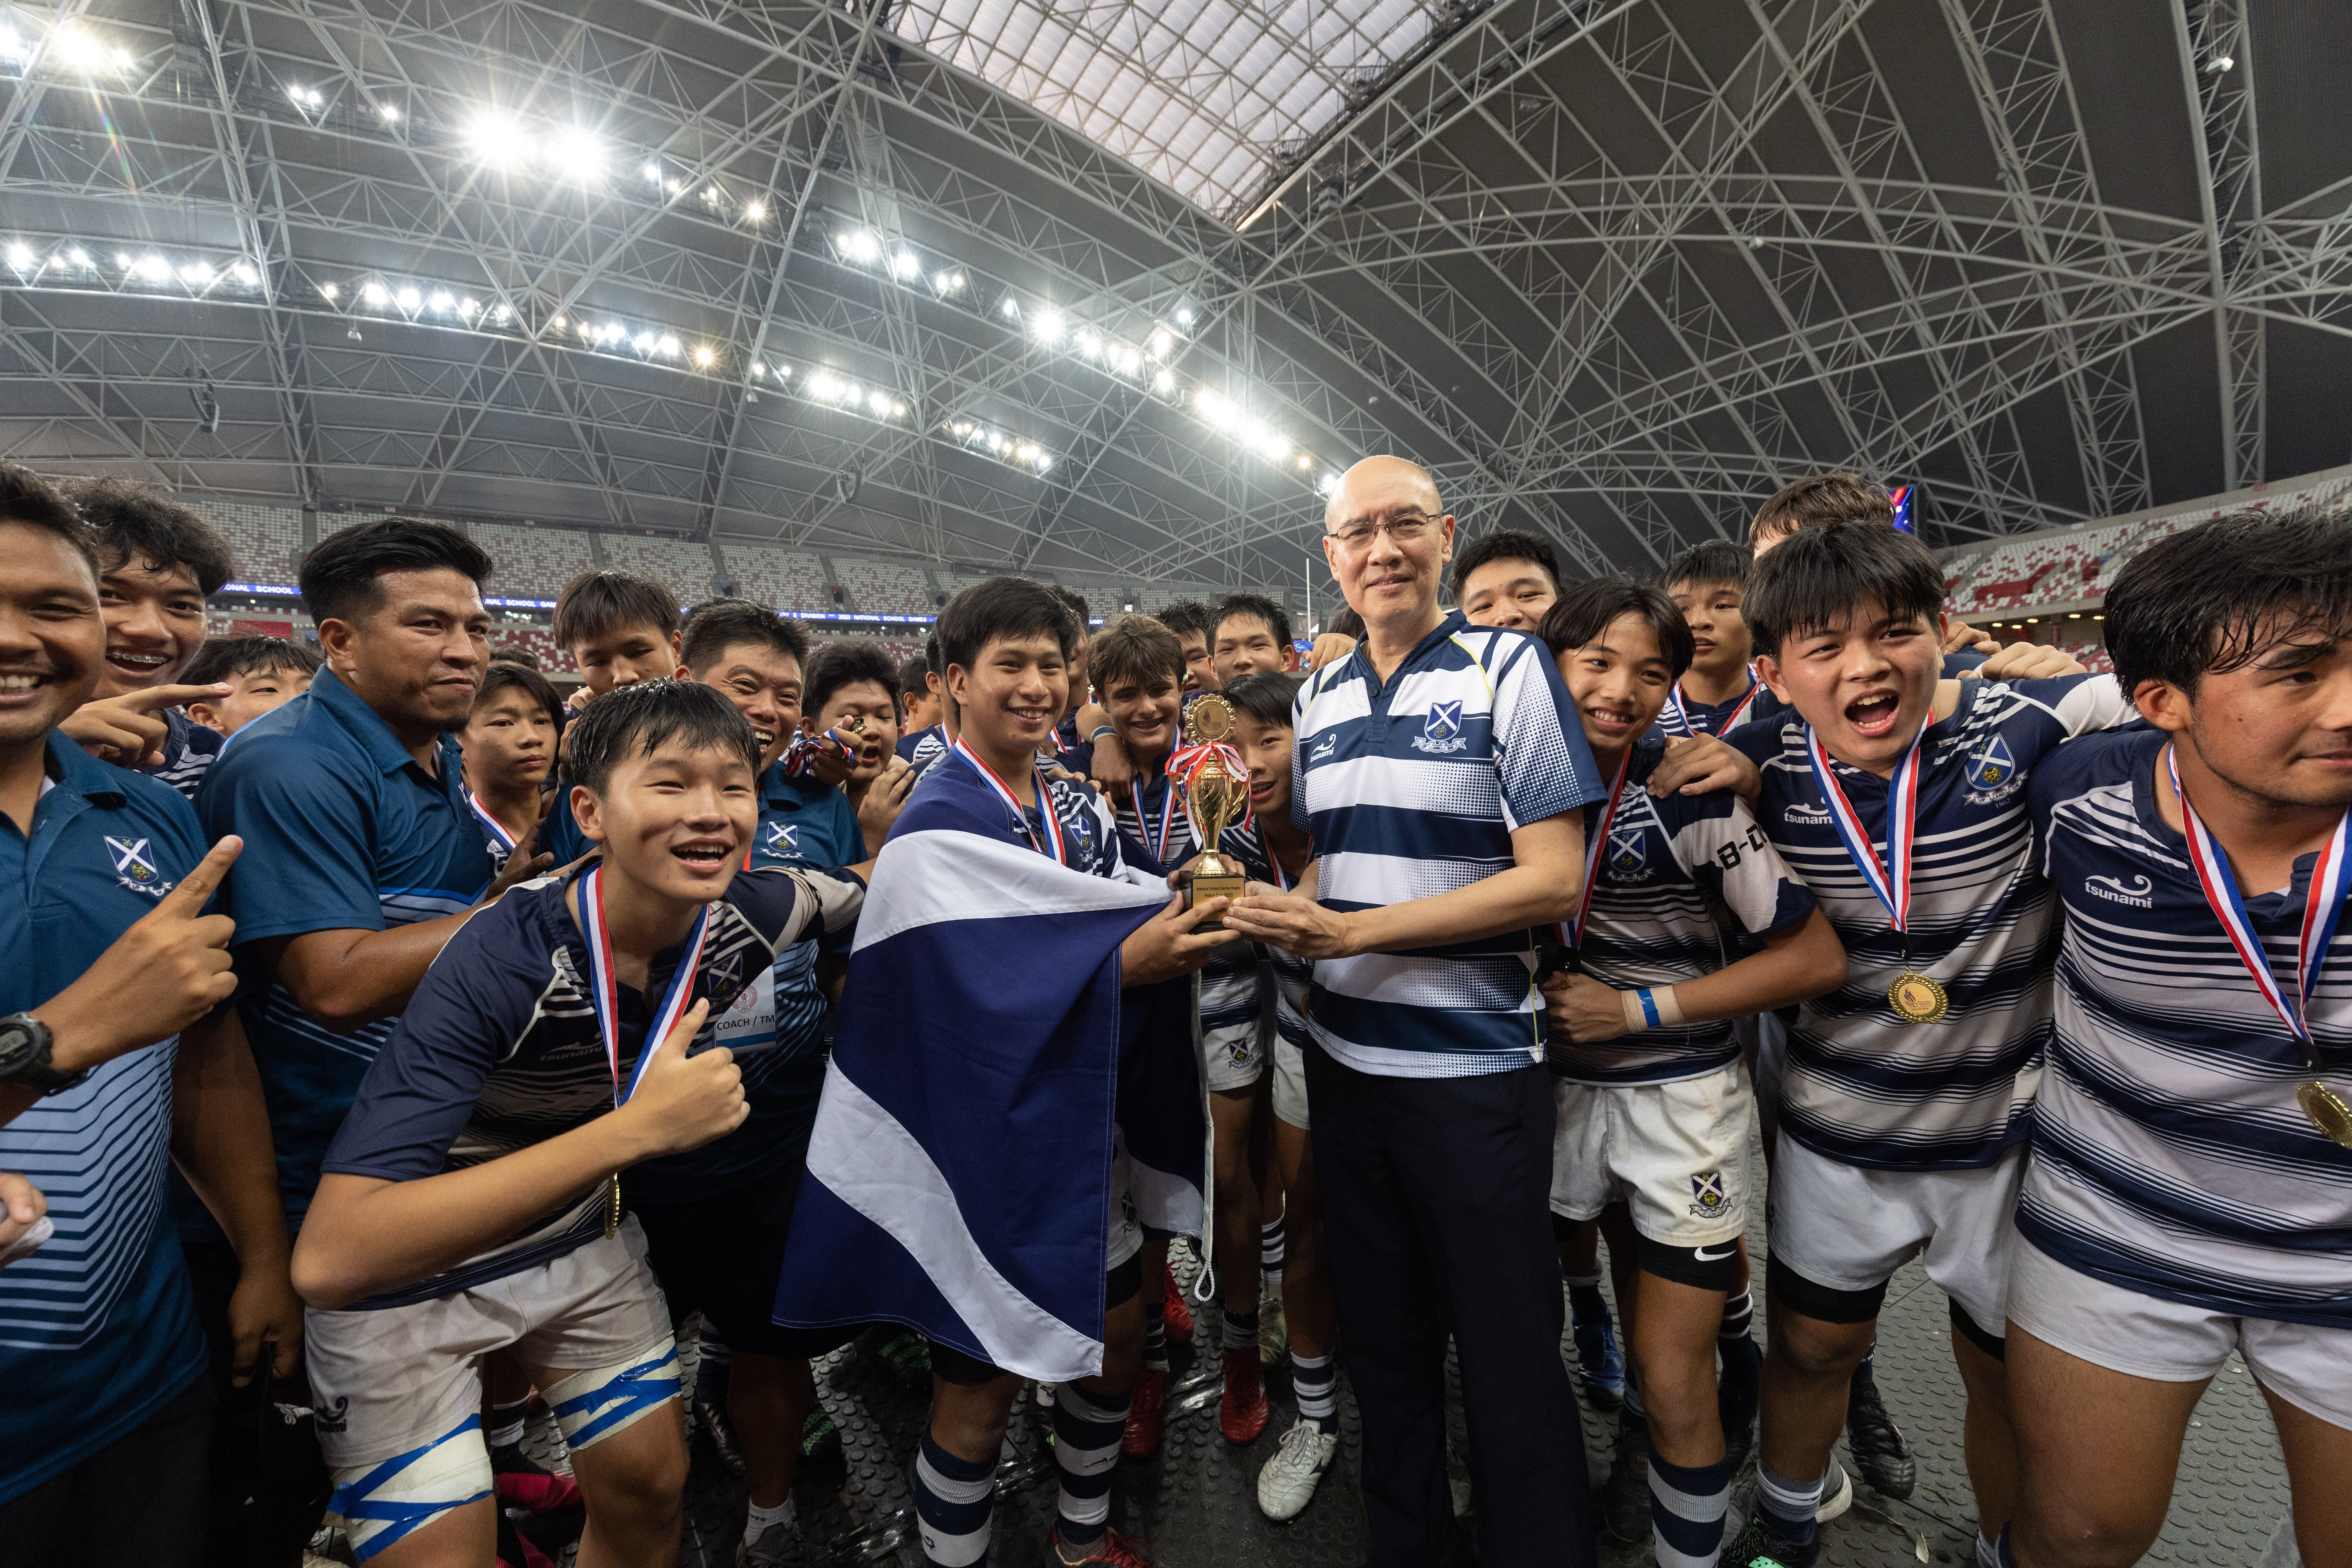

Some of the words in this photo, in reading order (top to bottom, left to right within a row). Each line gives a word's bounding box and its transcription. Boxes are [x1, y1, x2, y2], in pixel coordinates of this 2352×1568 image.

[256, 585, 294, 594] SCHOOL
[506, 599, 536, 607] SCHOOL
[1310, 746, 1334, 763] tsunami
[1995, 798, 2011, 809] 1862
[1784, 811, 1834, 824] tsunam
[2084, 882, 2152, 909] tsunami
[717, 1018, 750, 1031] COACH
[759, 1014, 775, 1024] TM
